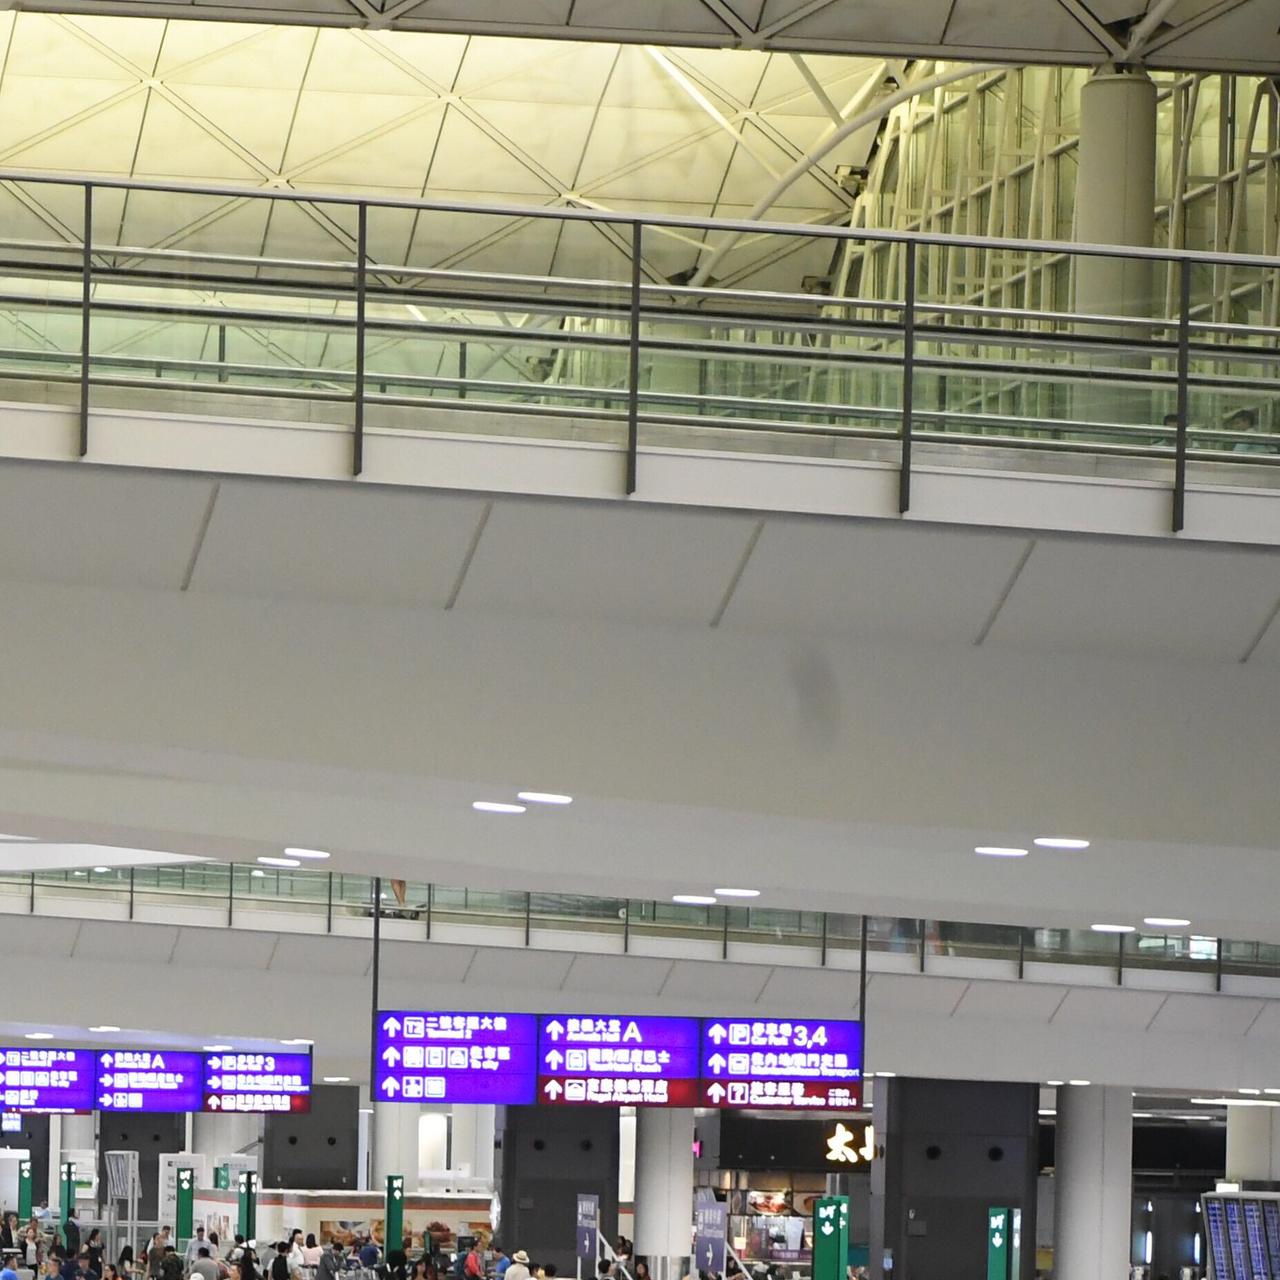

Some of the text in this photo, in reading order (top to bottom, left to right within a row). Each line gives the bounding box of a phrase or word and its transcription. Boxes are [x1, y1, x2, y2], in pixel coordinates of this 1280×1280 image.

[623, 1021, 642, 1043] A
[793, 1025, 828, 1048] 3,4
[151, 1054, 165, 1069] A
[264, 1056, 275, 1071] 3
[821, 1066, 860, 1077] Transport
